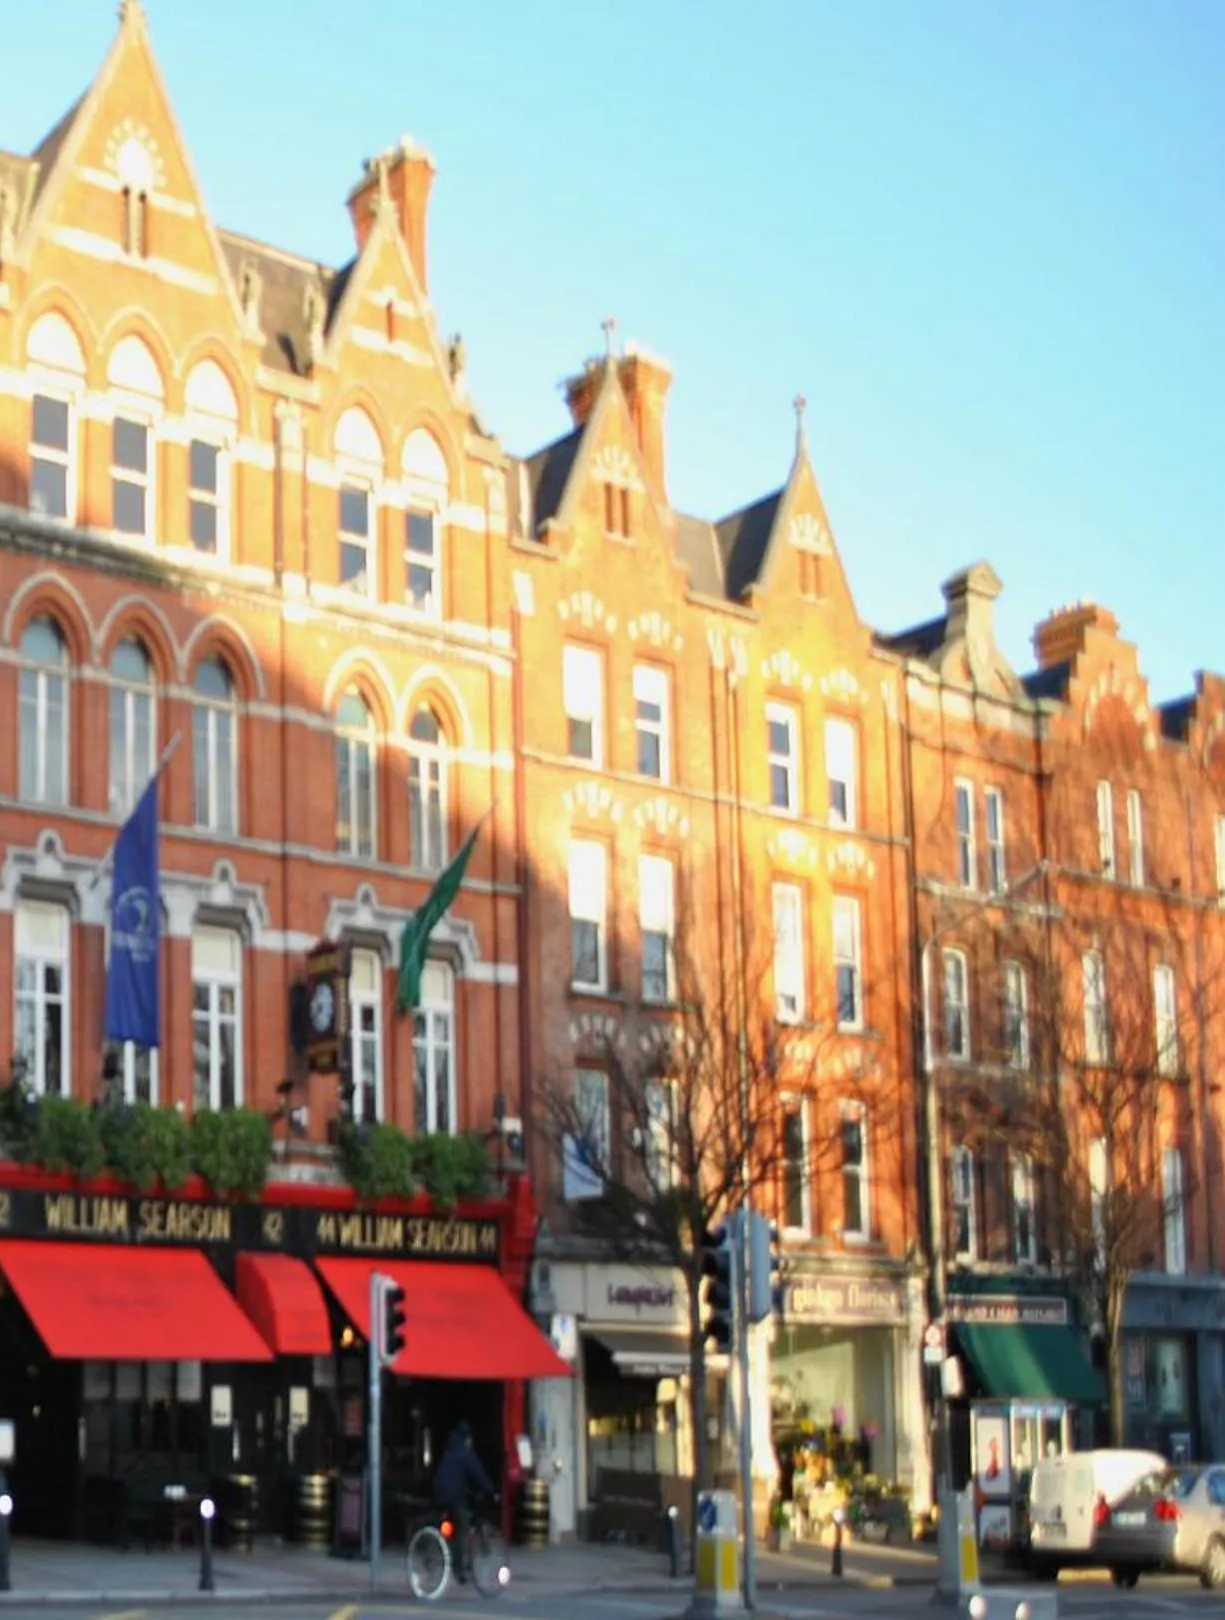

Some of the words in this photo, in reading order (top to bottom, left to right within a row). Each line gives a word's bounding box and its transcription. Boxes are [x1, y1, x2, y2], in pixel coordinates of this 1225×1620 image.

[44, 1193, 129, 1232] WILLIAM
[138, 1201, 232, 1242] SEARSON
[262, 1210, 285, 1244] 42
[339, 1213, 404, 1249] WILLIAM
[407, 1219, 477, 1255] SEARSON
